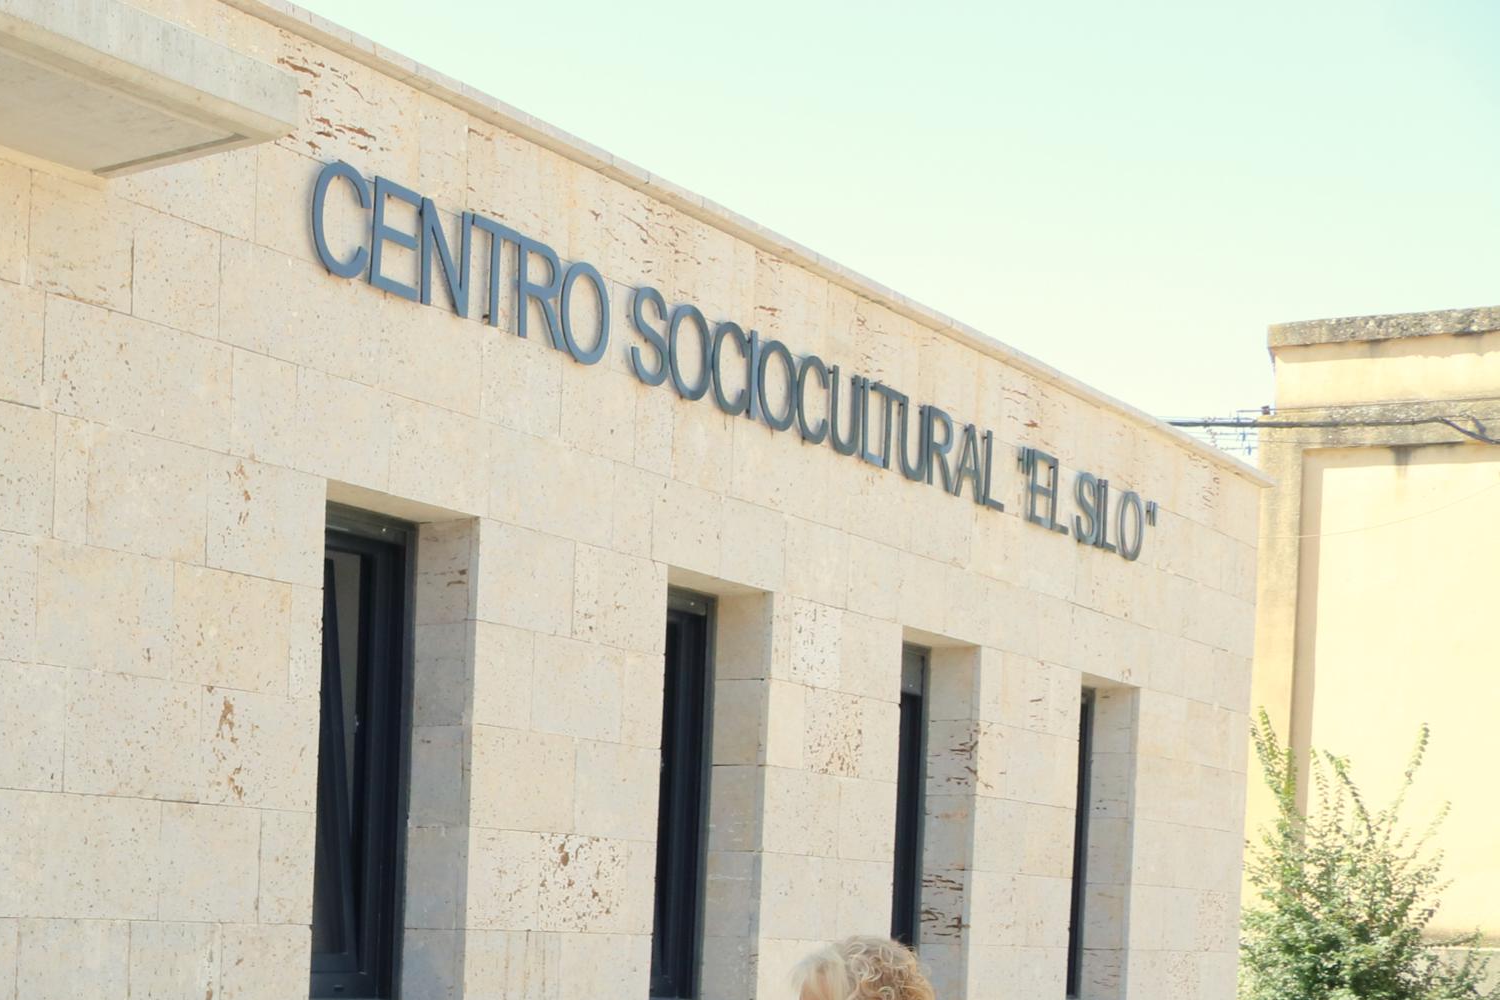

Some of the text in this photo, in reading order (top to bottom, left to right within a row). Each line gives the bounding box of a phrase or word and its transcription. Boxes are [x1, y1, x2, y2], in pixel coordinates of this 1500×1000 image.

[311, 160, 1158, 562] CENTRO SOCIOCULTURAL "EL SILO"
